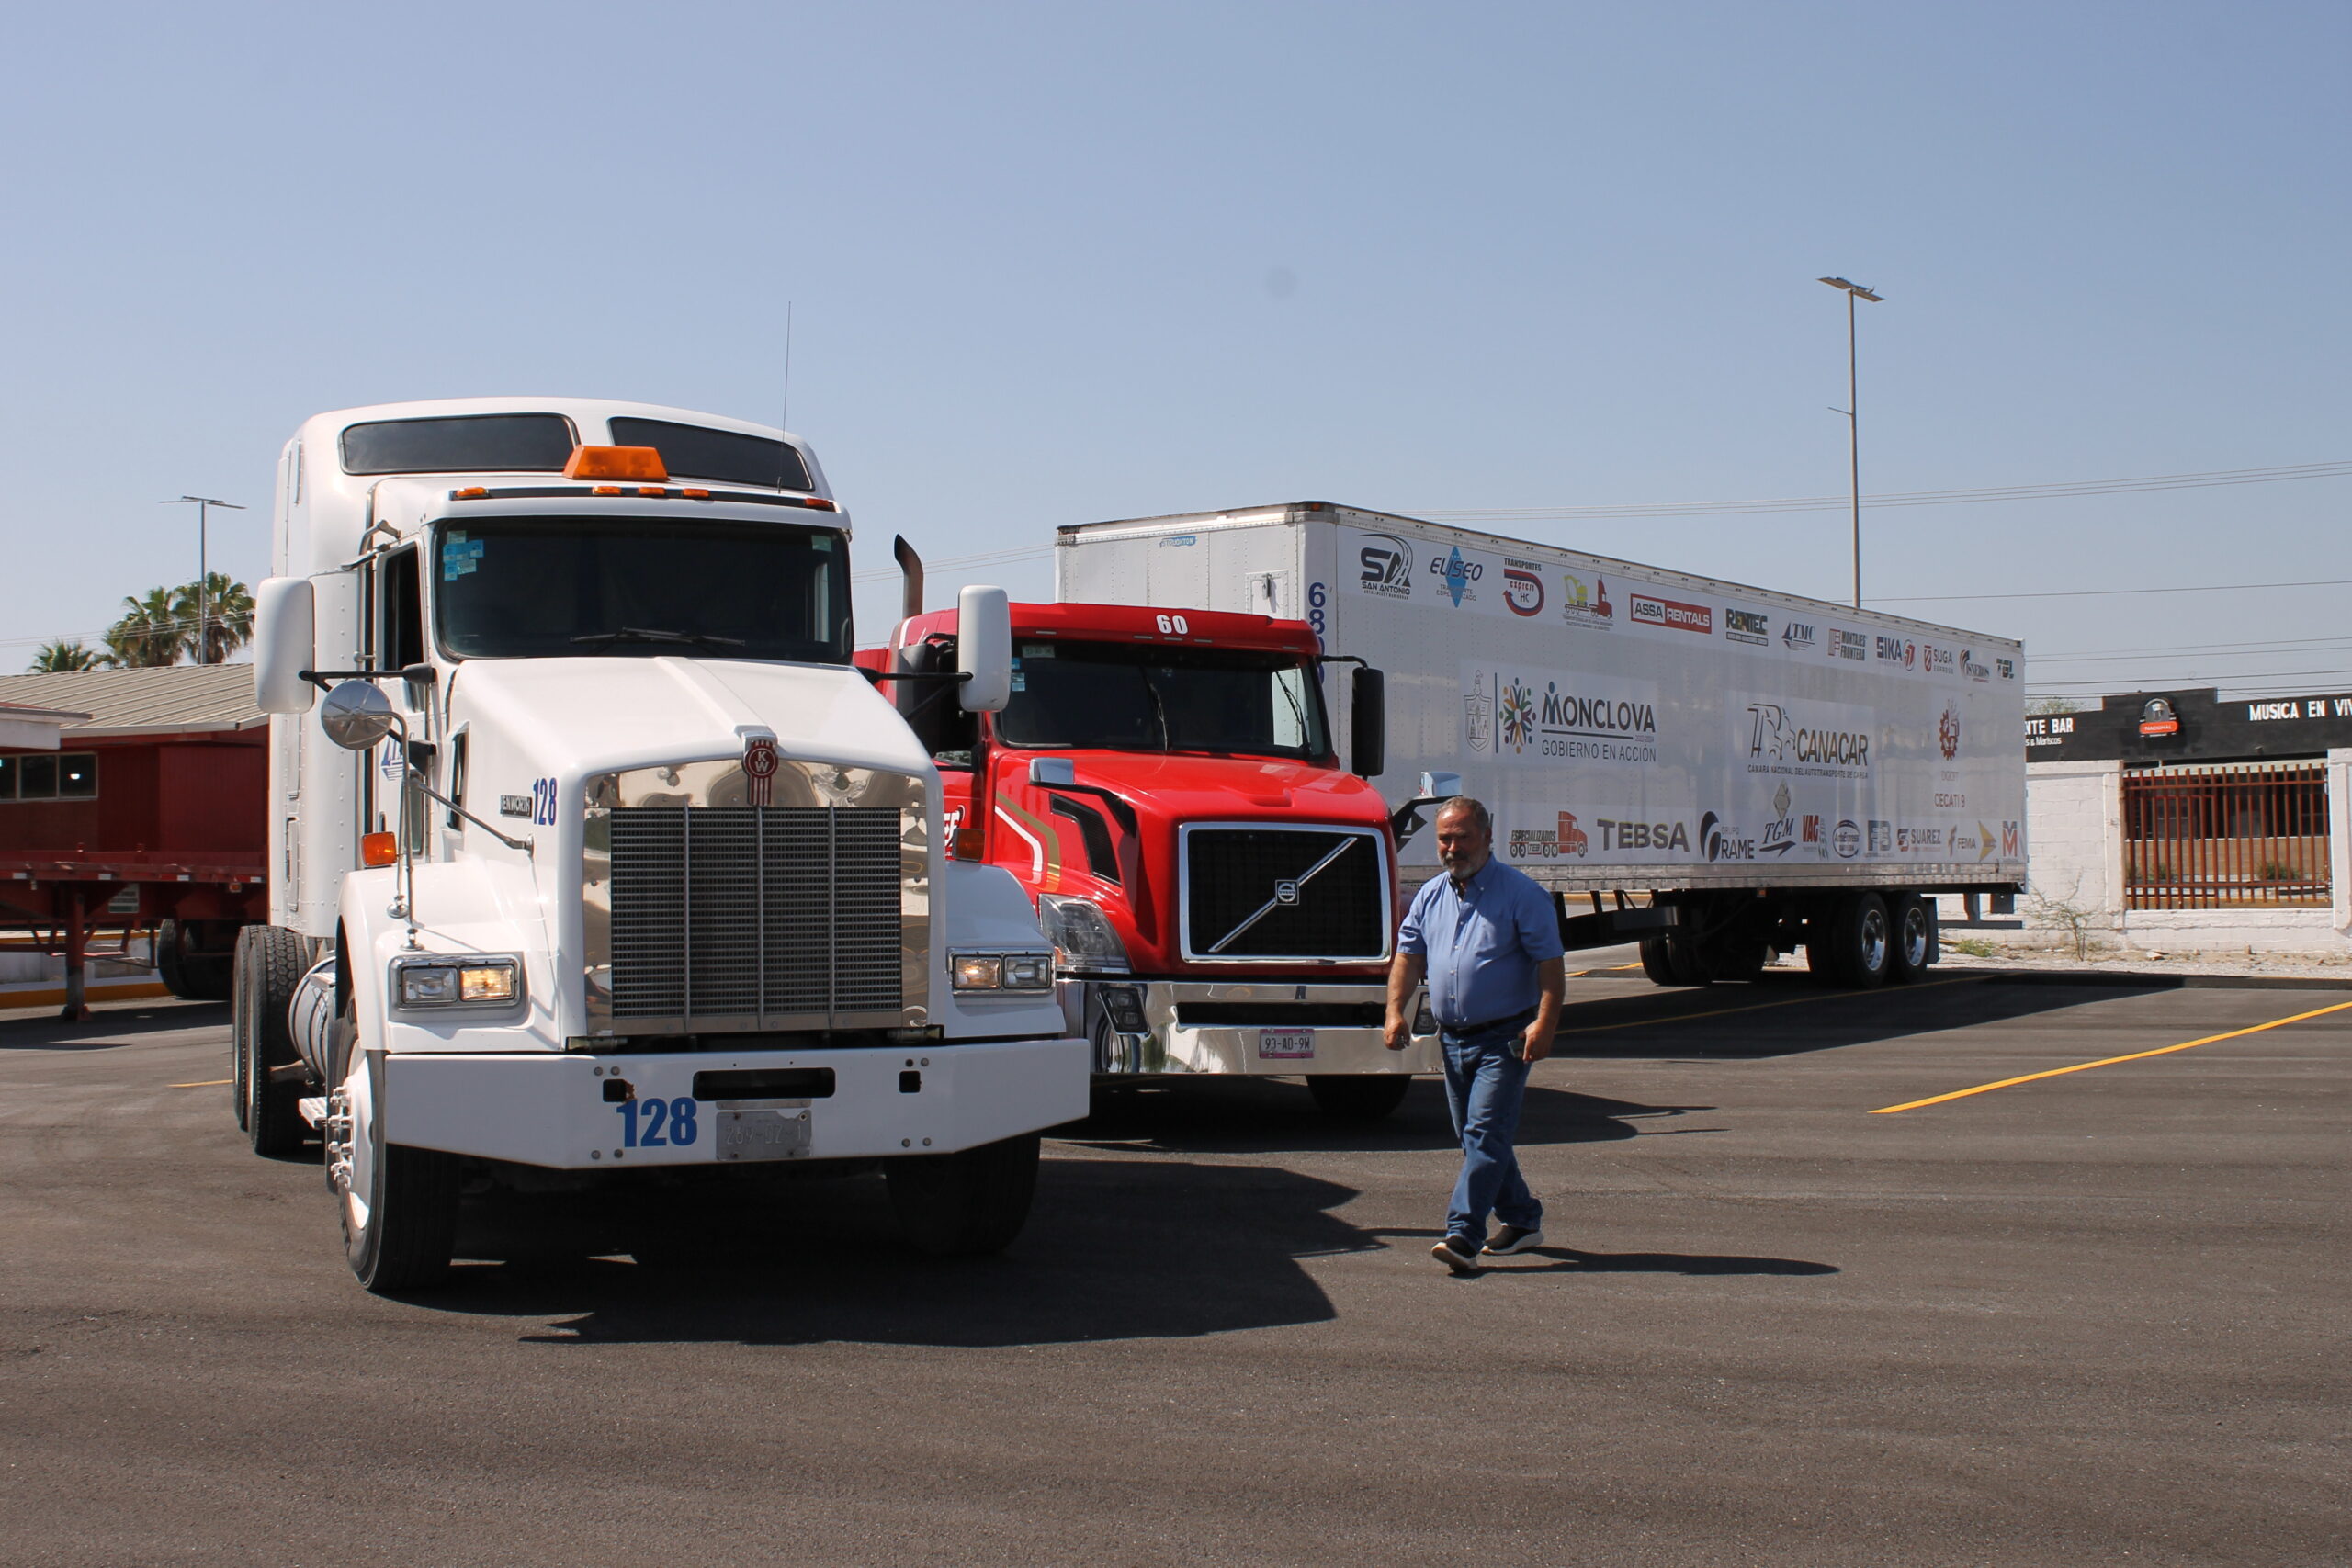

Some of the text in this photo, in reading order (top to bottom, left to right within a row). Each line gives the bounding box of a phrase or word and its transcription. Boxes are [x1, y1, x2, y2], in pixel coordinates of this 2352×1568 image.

[1430, 557, 1483, 581] ELISEO
[1504, 558, 1542, 571] TRANSPORTES
[1362, 581, 1410, 595] SAN ANTONIO
[1156, 615, 1188, 635] 60
[1635, 603, 1710, 627] ASSA RENTALS
[1876, 636, 1902, 661] SIKA
[1934, 649, 1953, 664] SUGA
[1541, 692, 1656, 733] MONCLOVA
[2249, 702, 2300, 721] MUSICA
[2308, 700, 2325, 717] EN
[2051, 717, 2074, 734] BAR
[758, 750, 767, 761] K
[1542, 739, 1656, 761] GOBIERNO EN ACCIÓN
[1797, 728, 1868, 766] CANACAR
[755, 761, 769, 772] W
[533, 777, 557, 826] 128
[1511, 830, 1556, 842] ESPECIALIZADOS
[1597, 818, 1690, 852] TEBSA
[1911, 829, 1941, 844] SUAREZ
[1958, 838, 1976, 849] FEMA
[1721, 839, 1754, 859] RAME
[616, 1097, 697, 1147] 128
